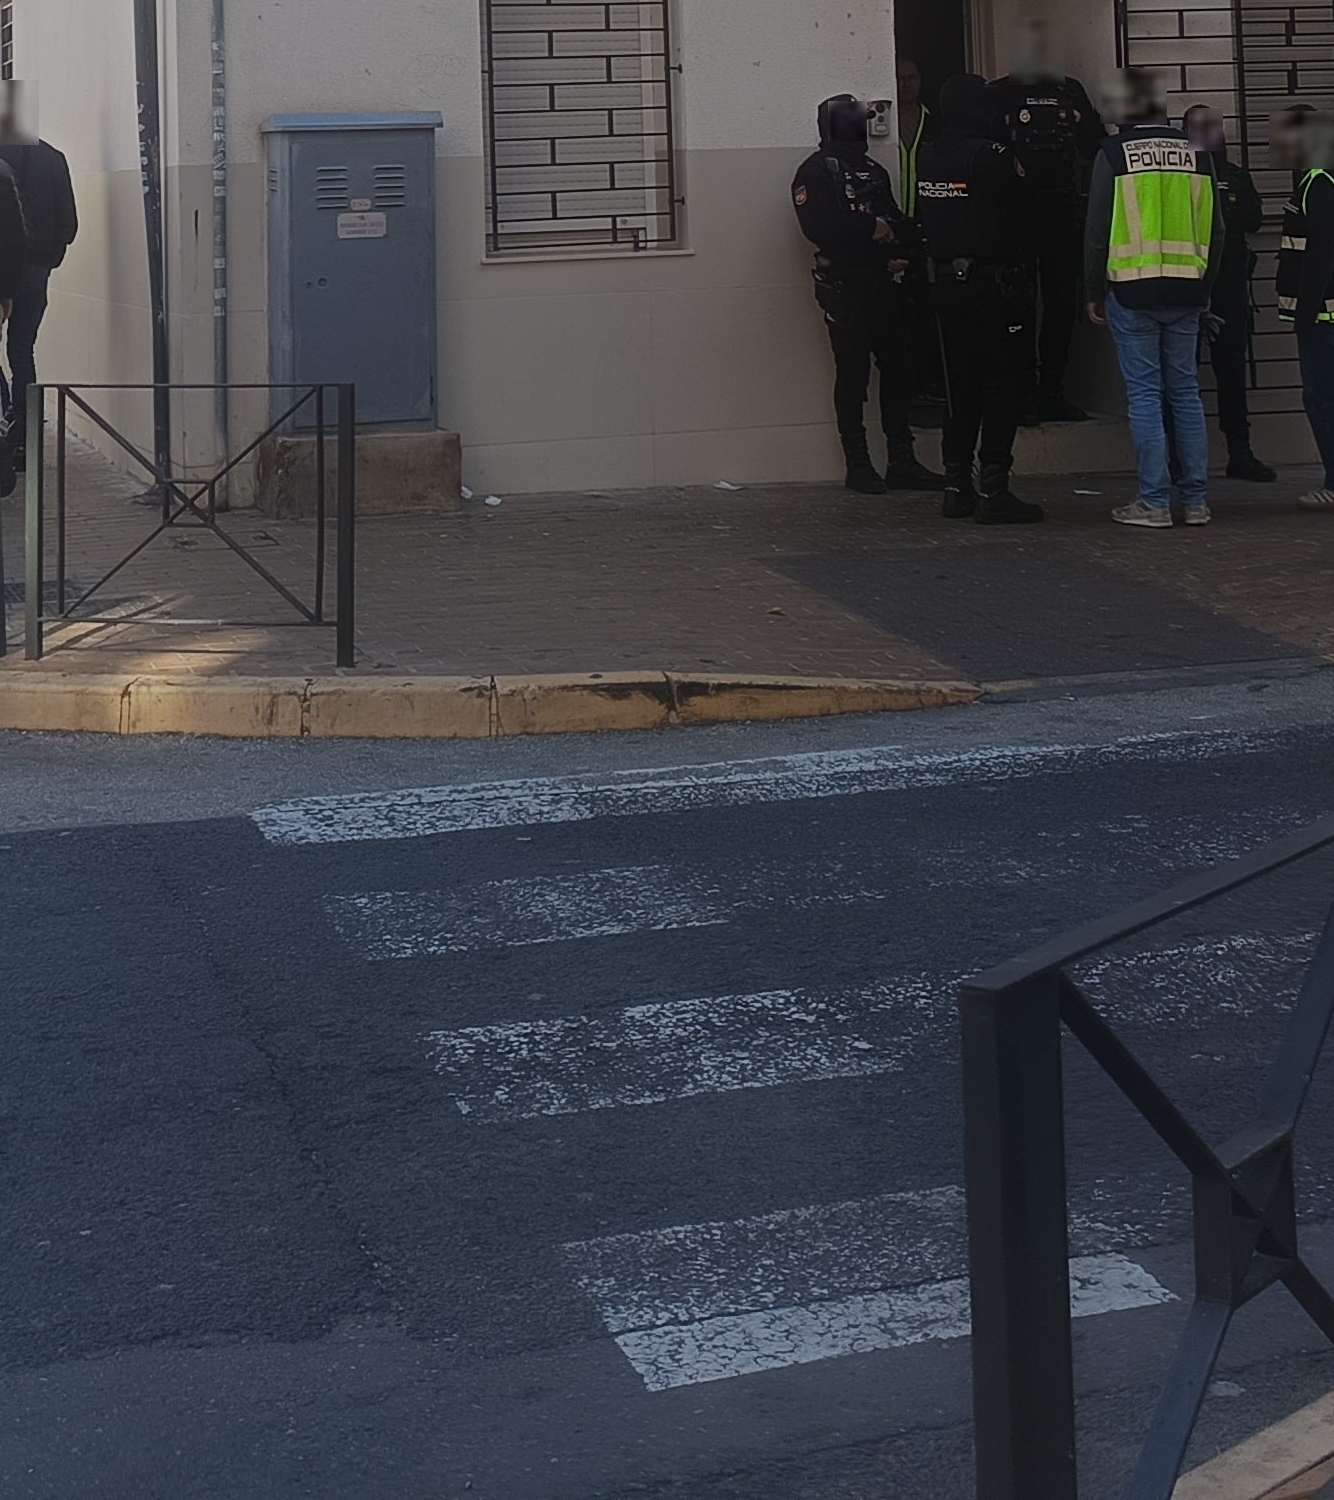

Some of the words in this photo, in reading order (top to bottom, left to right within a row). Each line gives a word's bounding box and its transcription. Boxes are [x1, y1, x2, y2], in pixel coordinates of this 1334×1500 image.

[1126, 141, 1153, 151] CUERPO
[1154, 140, 1183, 149] NACIONAL
[1128, 151, 1193, 168] POLICIA
